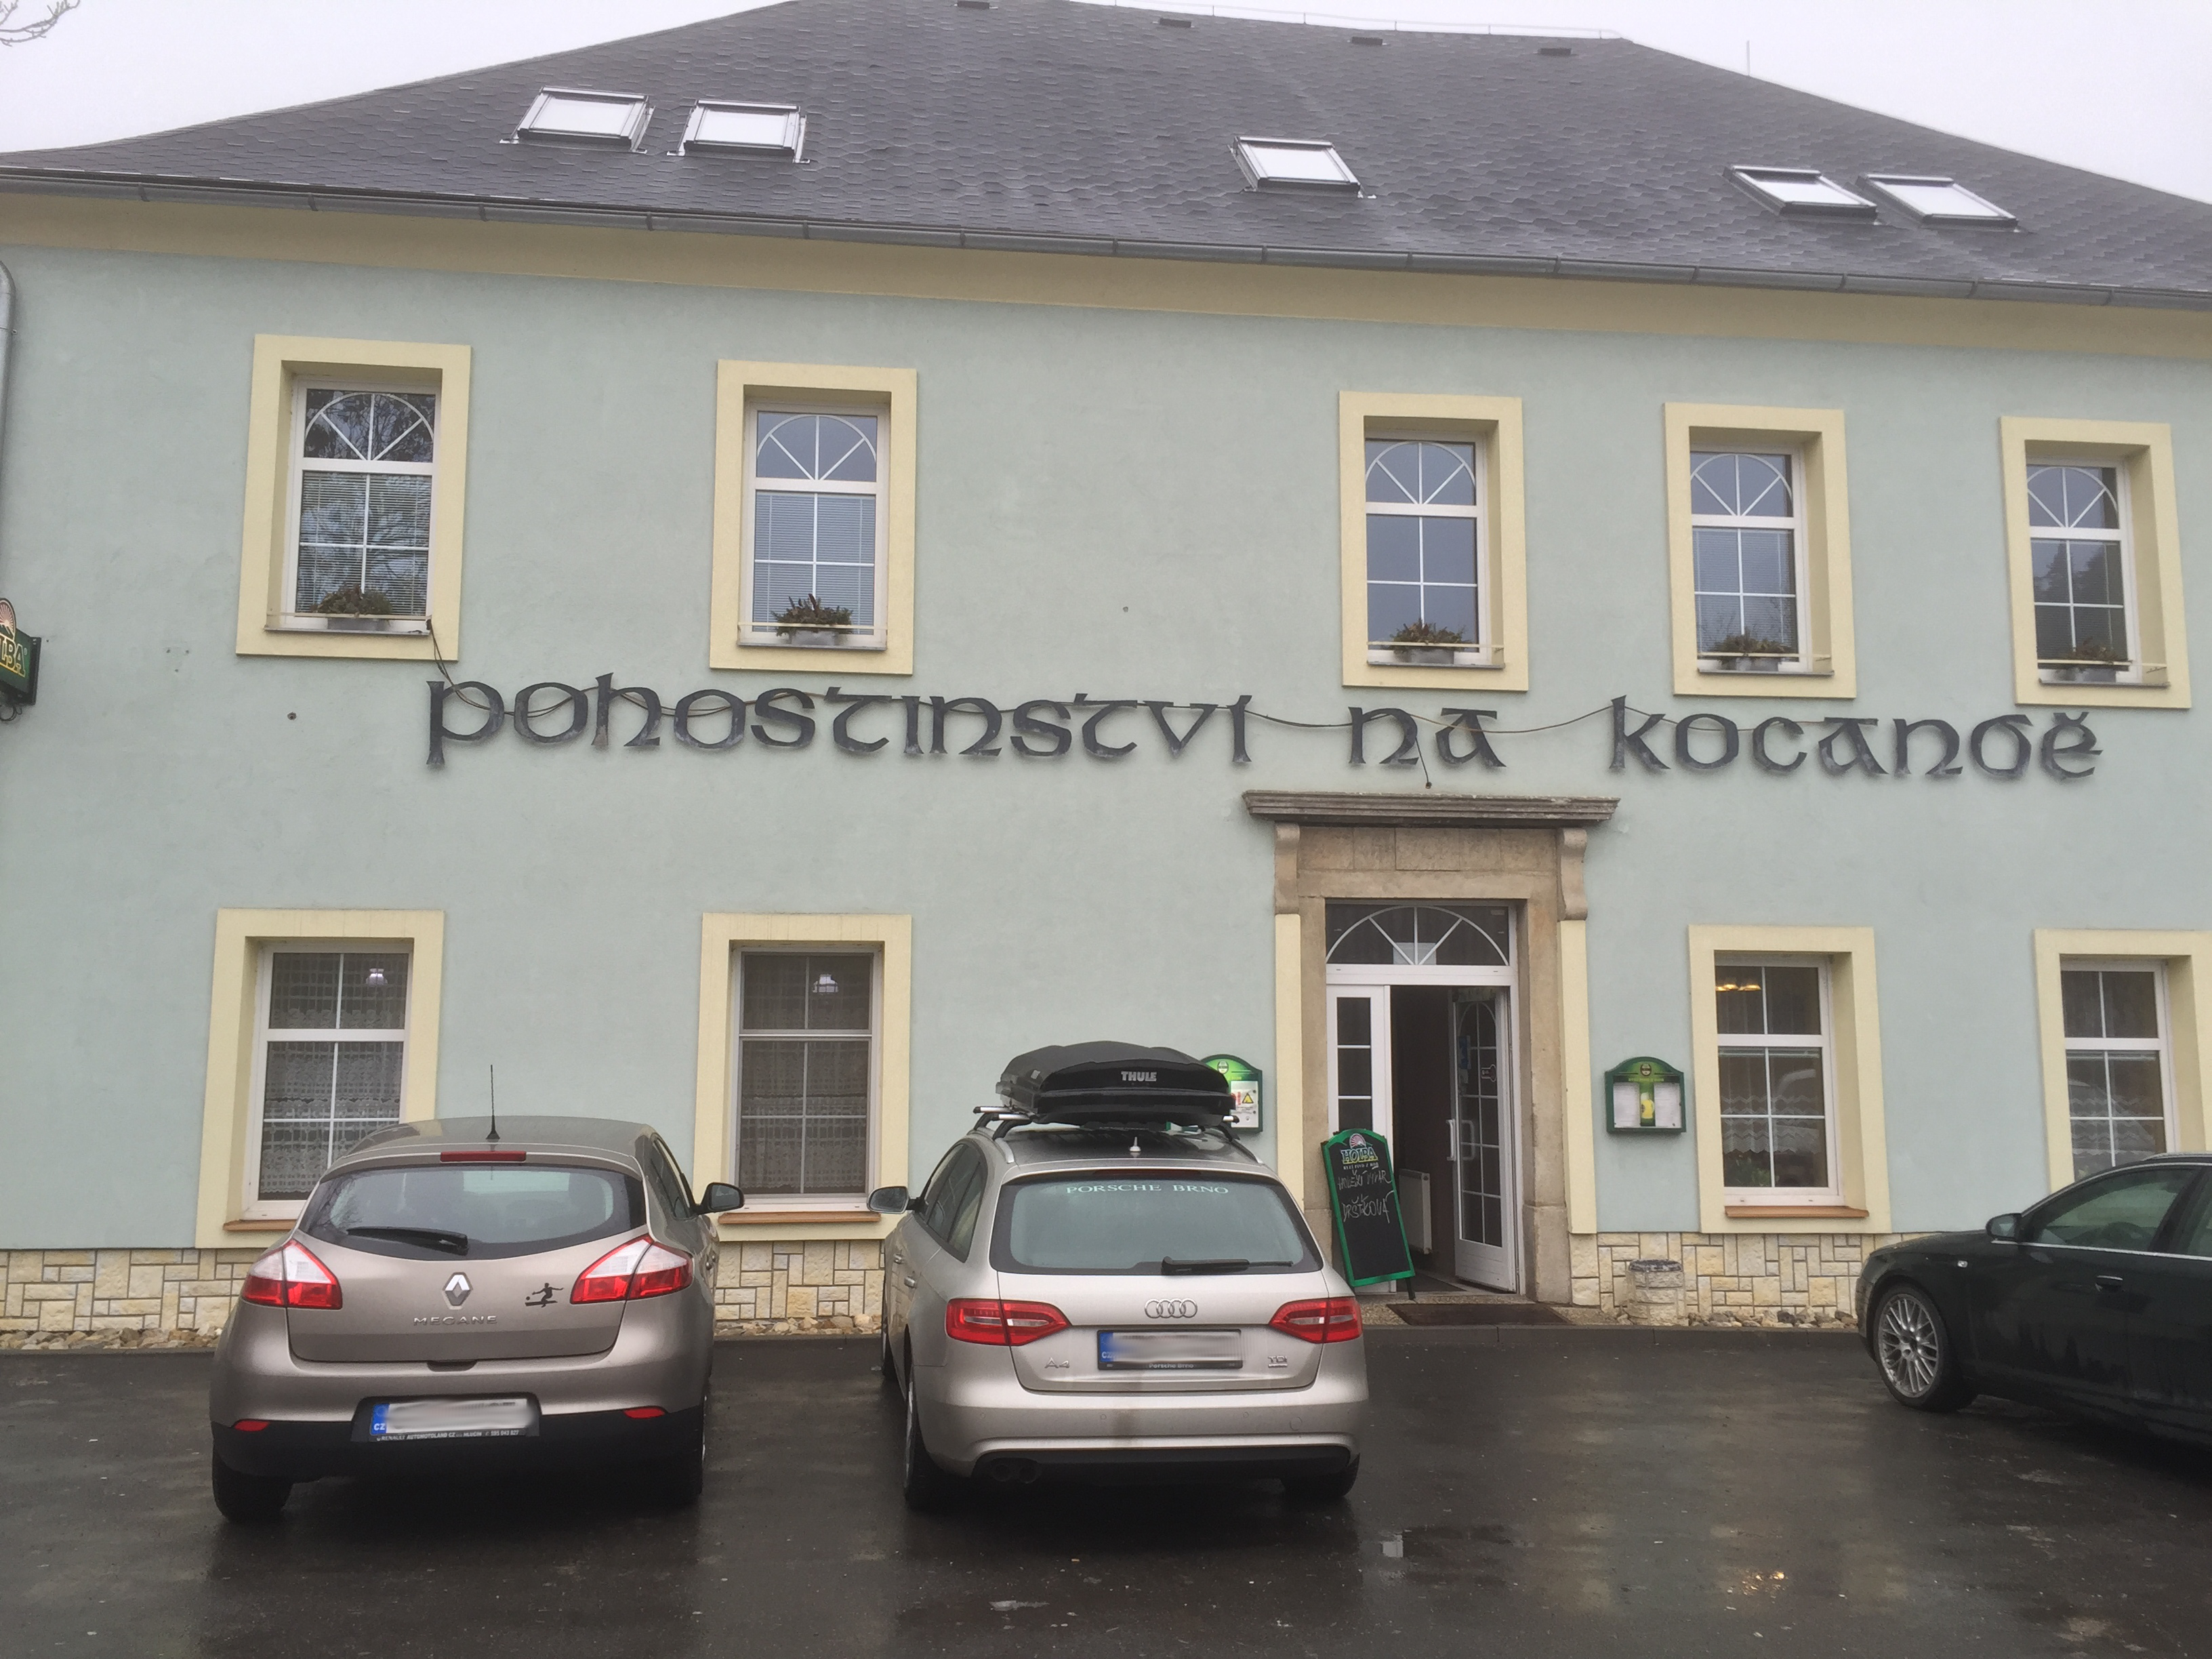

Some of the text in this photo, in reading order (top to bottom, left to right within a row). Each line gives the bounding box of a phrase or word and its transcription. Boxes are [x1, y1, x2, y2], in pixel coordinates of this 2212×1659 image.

[1120, 1071, 1158, 1082] THULE
[1340, 1147, 1378, 1164] HOLBA
[1066, 1184, 1229, 1194] PORSCHE BRNO
[1044, 1357, 1070, 1369] A4
